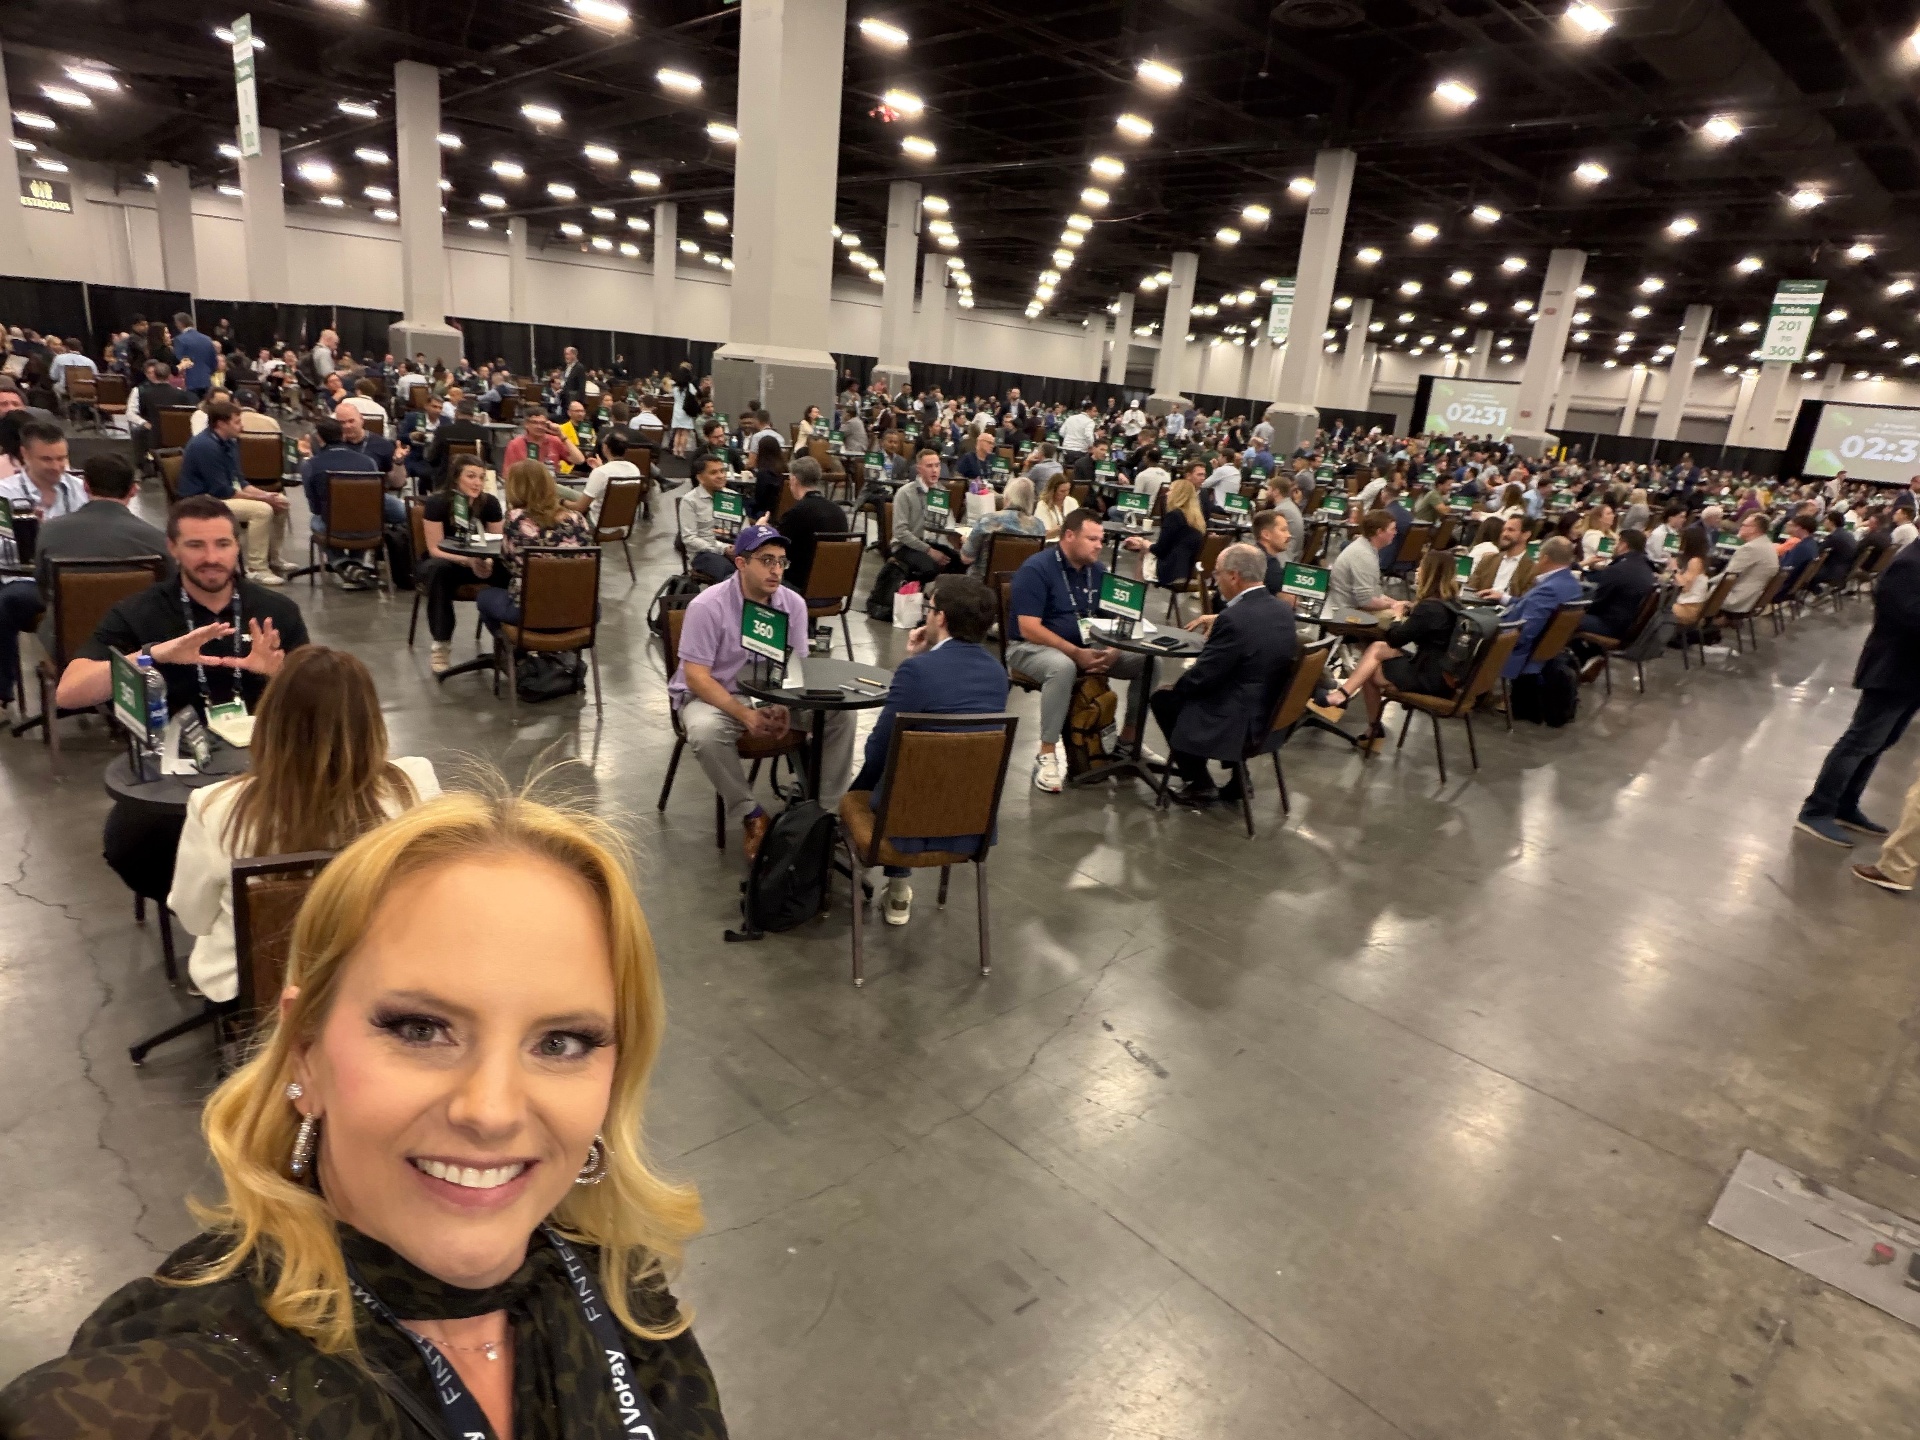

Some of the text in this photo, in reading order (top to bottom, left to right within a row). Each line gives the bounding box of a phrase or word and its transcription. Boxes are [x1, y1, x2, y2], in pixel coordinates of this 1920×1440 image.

[1777, 321, 1802, 331] 201
[1768, 345, 1796, 356] 300
[1446, 402, 1508, 427] 02:31
[1840, 435, 1920, 464] 02:3
[1294, 574, 1316, 586] 350
[1112, 588, 1130, 603] 351
[752, 619, 774, 639] 360
[604, 1350, 642, 1426] VoPay
